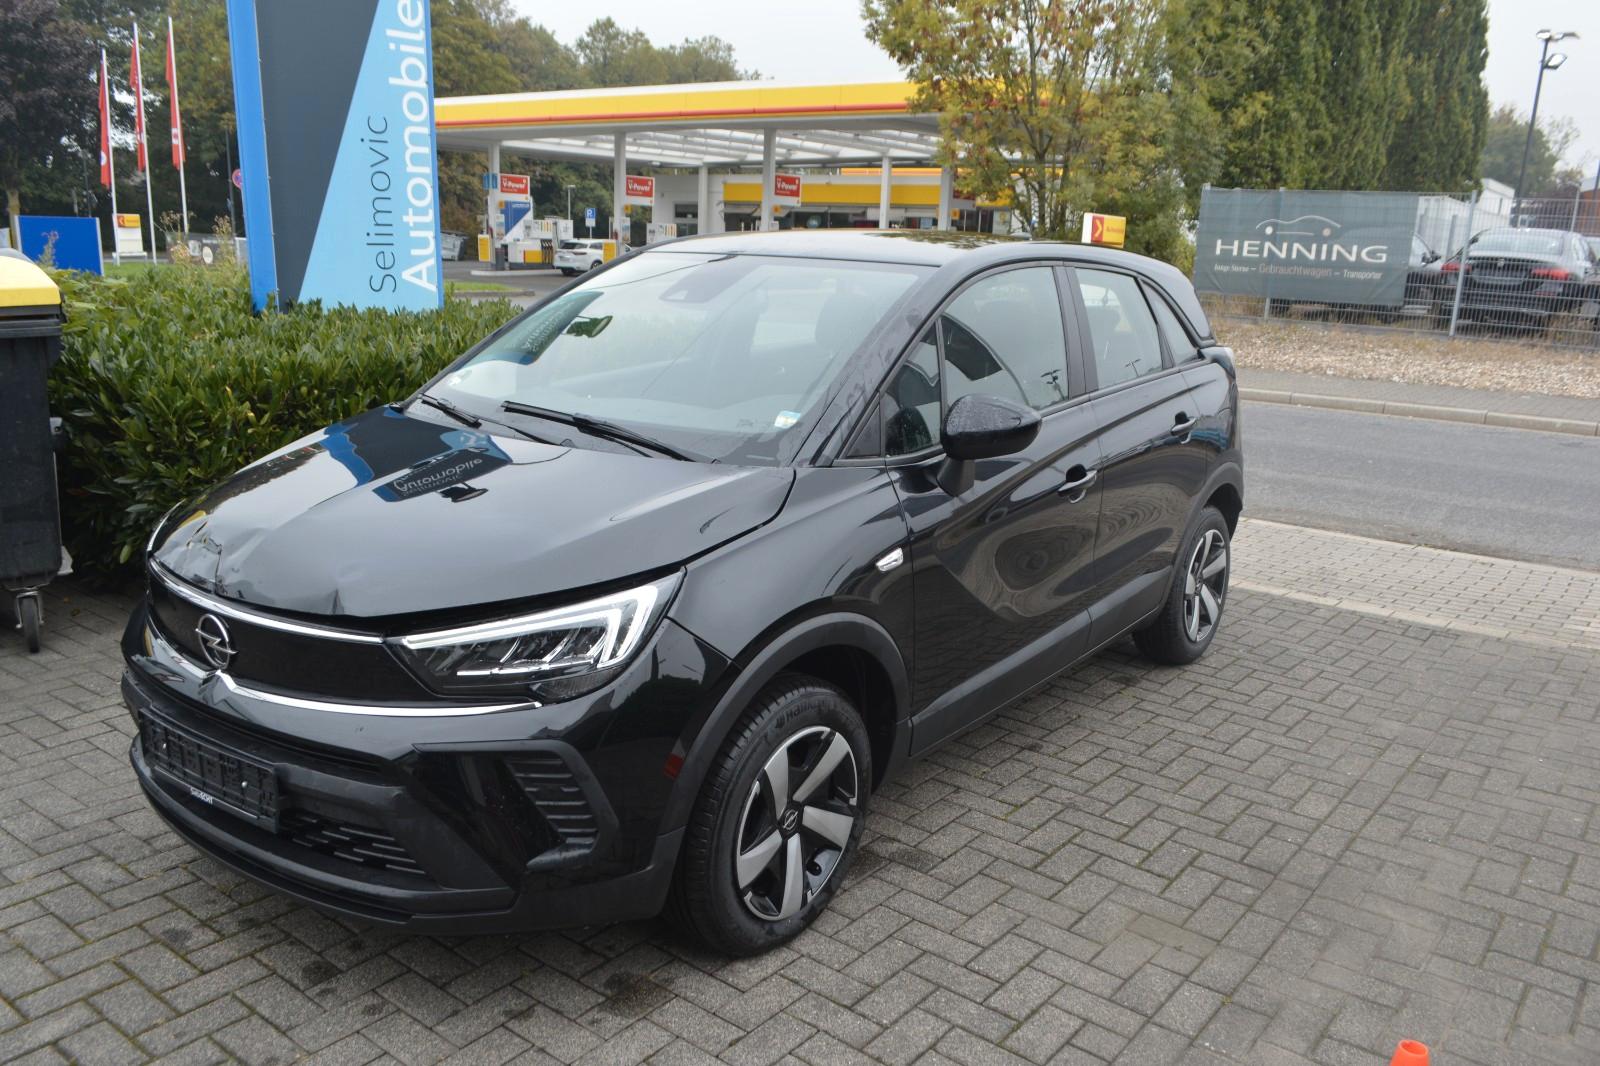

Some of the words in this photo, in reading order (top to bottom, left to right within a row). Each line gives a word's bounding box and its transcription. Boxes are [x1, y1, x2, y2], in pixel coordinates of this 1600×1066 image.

[385, 0, 437, 292] Automobile
[360, 116, 397, 293] Selimovic
[1215, 239, 1388, 263] HENNING
[1258, 263, 1332, 279] Gebrauchtwagen
[1343, 269, 1384, 280] Transporter
